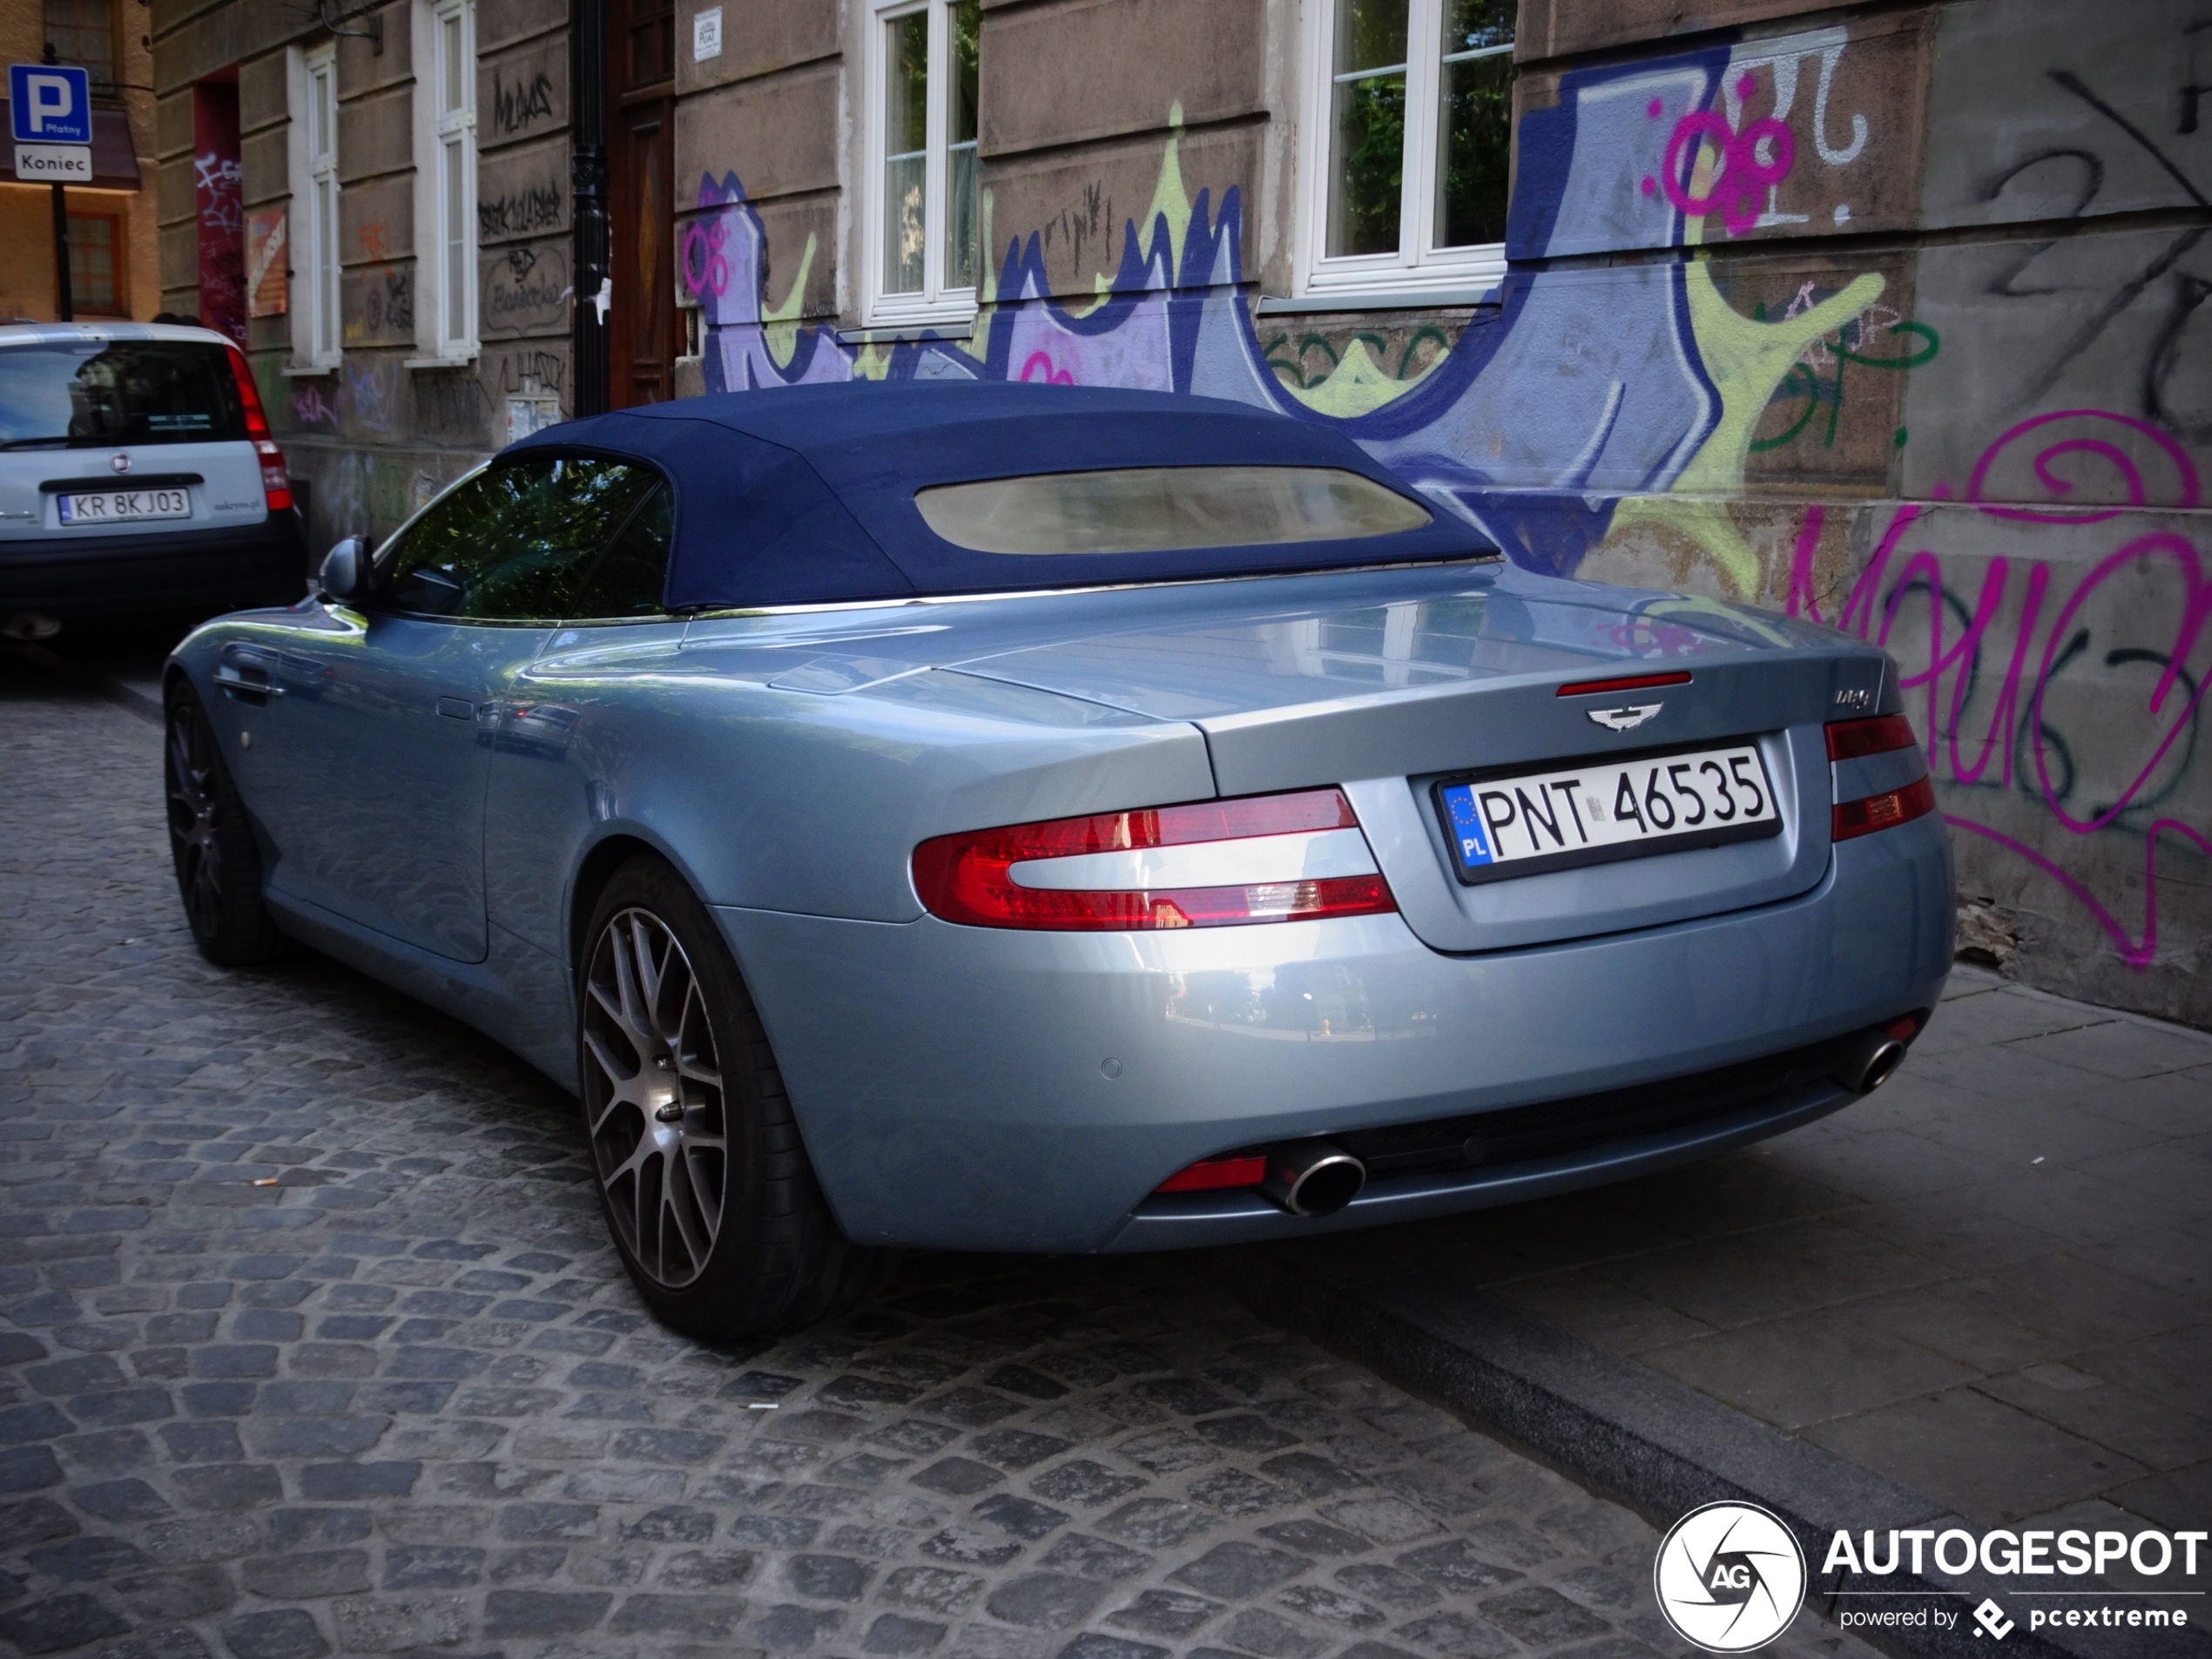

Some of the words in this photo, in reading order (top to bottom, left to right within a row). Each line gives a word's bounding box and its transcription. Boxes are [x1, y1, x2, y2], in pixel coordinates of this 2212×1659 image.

[26, 74, 72, 132] P
[45, 123, 81, 137] Płatny
[22, 154, 85, 171] Koniec
[75, 496, 106, 517] KR
[114, 492, 184, 514] 8KJ03
[1478, 779, 1588, 857] PNT
[1613, 756, 1764, 833] 46535
[1463, 839, 1486, 858] PL
